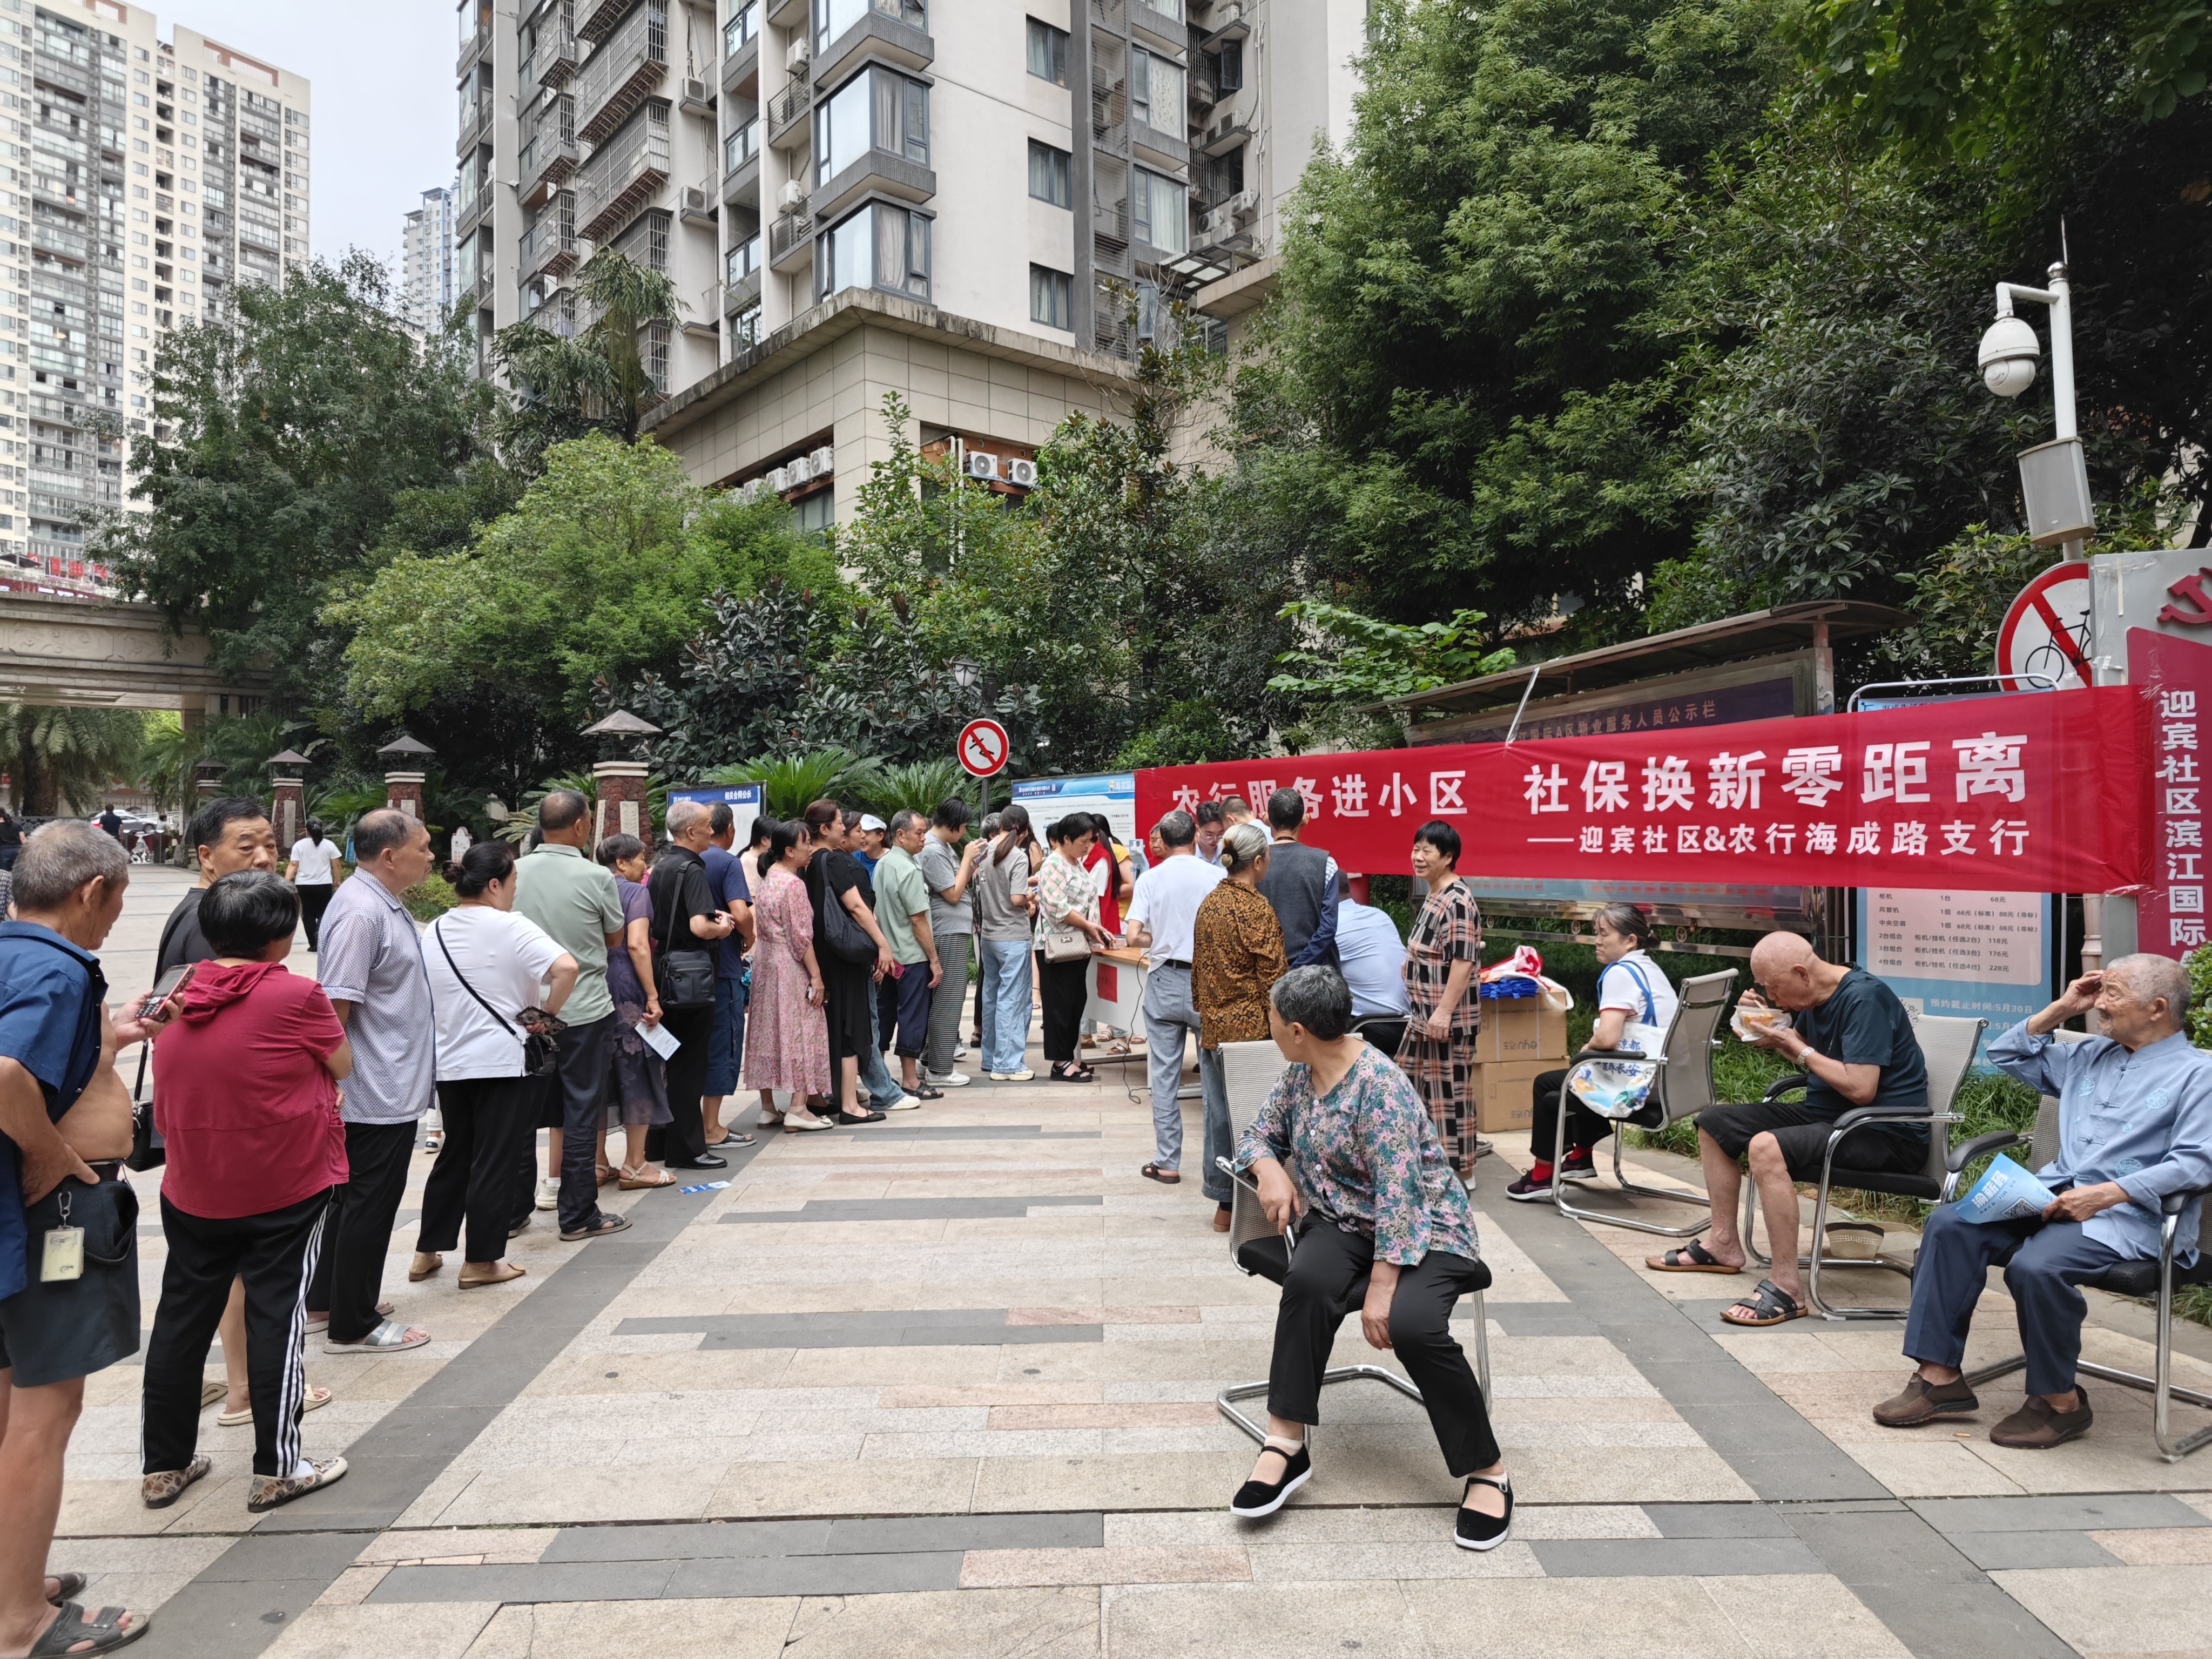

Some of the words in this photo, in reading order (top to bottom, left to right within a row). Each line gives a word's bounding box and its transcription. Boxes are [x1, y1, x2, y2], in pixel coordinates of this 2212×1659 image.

[1523, 731, 2028, 814] 社保换新零距离
